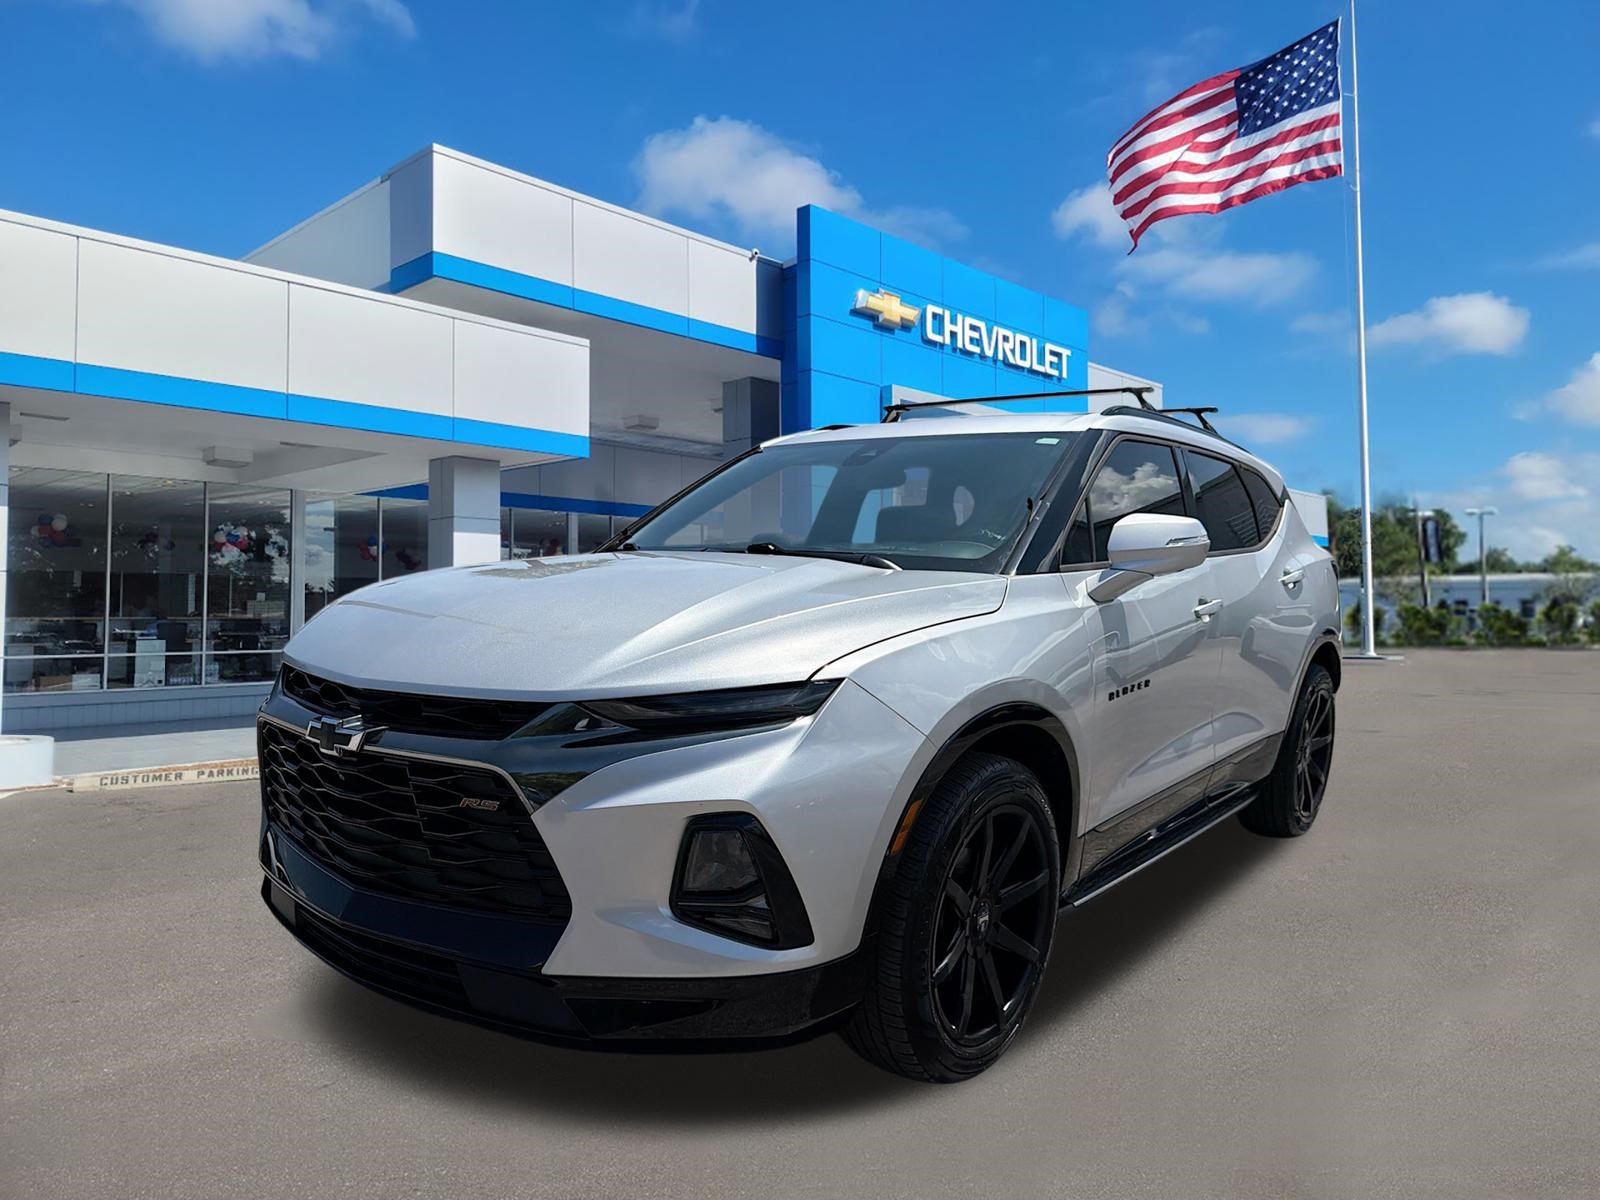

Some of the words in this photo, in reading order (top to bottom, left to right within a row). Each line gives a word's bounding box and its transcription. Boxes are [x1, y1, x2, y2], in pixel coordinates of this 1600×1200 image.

[925, 304, 1072, 379] CHEVROLET
[99, 771, 184, 786] CUSTOMER
[196, 766, 259, 779] PARKING
[460, 797, 499, 811] RS
